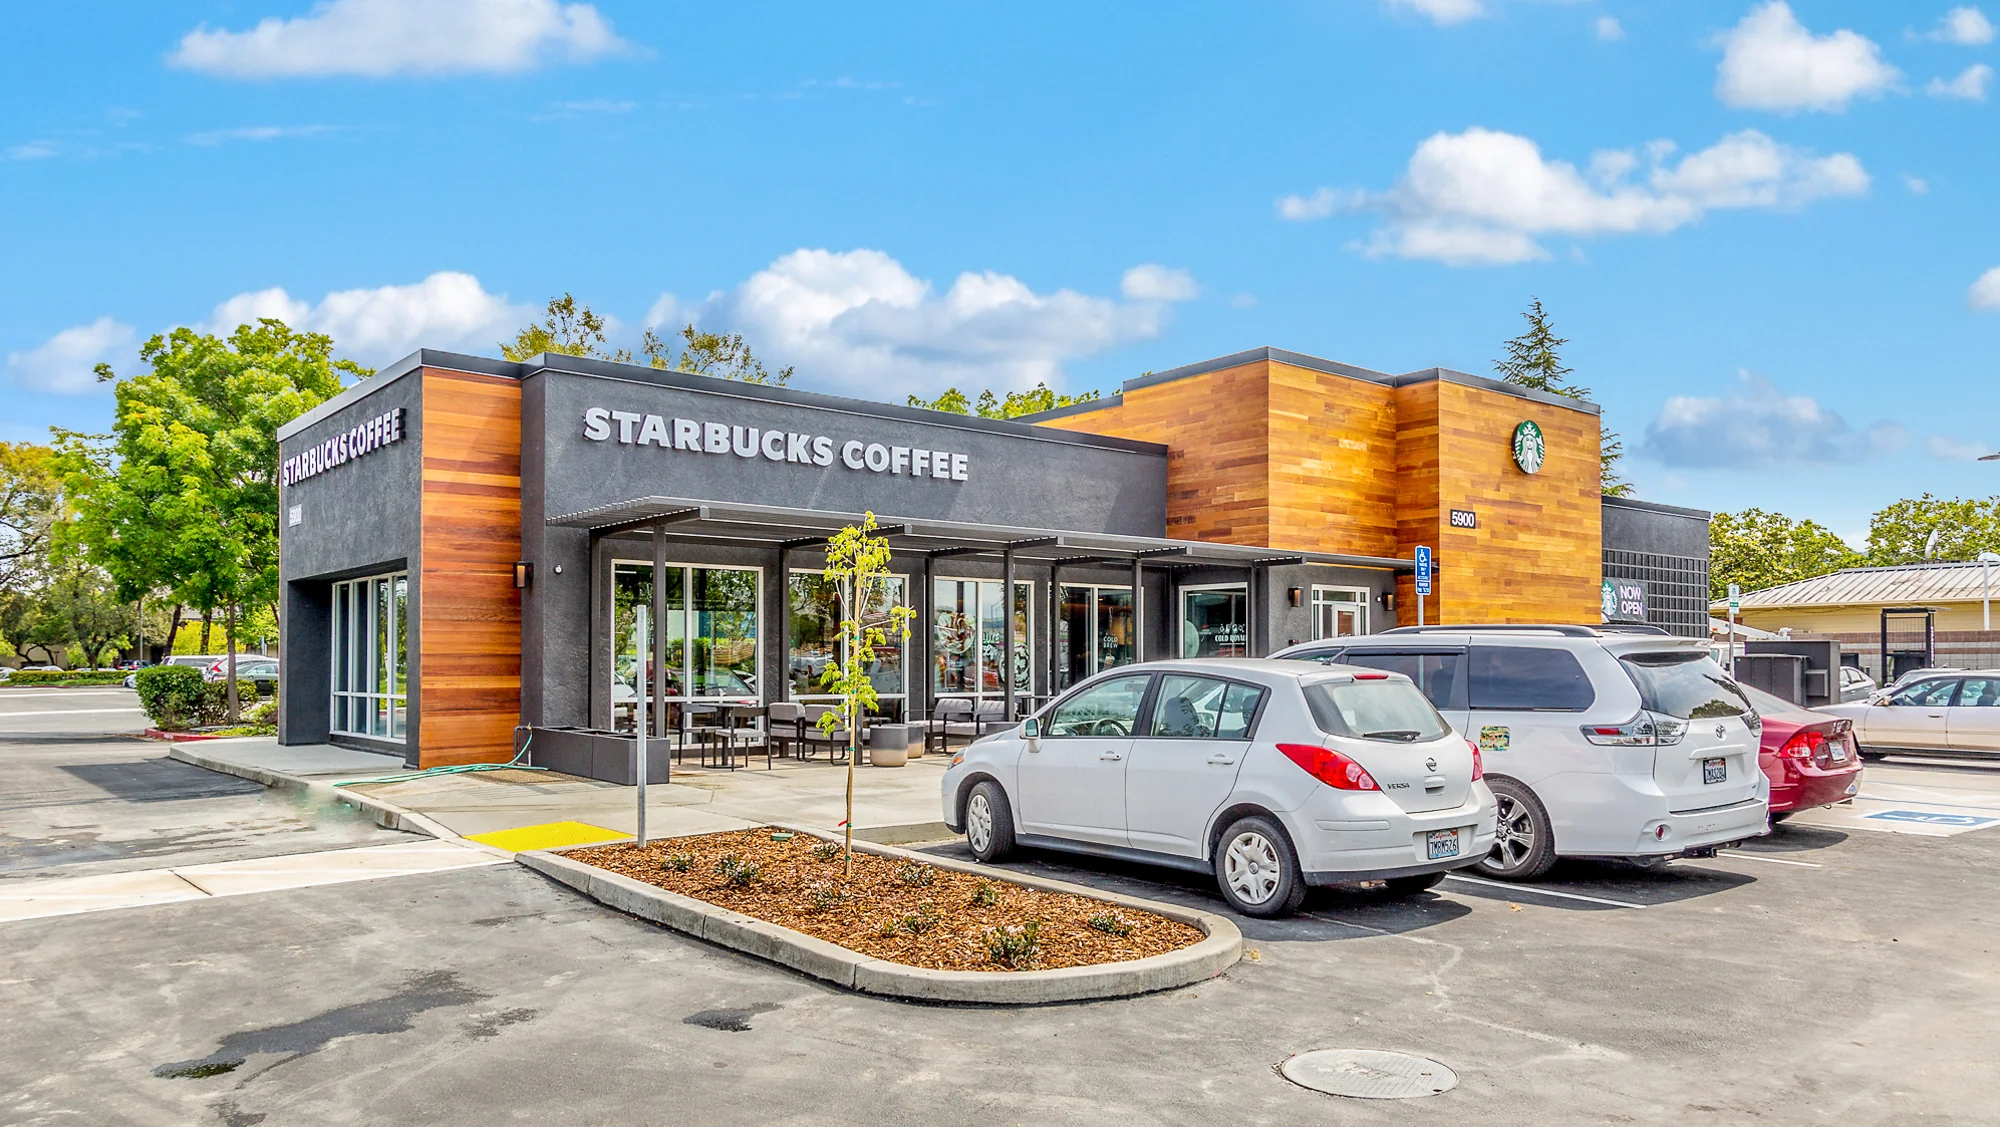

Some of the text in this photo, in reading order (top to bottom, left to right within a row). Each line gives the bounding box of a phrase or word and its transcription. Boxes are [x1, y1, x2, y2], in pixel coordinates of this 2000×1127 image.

[282, 407, 402, 487] STARBUCKS COFFEE
[583, 406, 969, 482] STARBUCKS COFFEE
[1451, 511, 1475, 527] 5900
[1619, 585, 1642, 600] NOW
[1621, 600, 1643, 615] OPEN
[1387, 782, 1410, 790] VERSA
